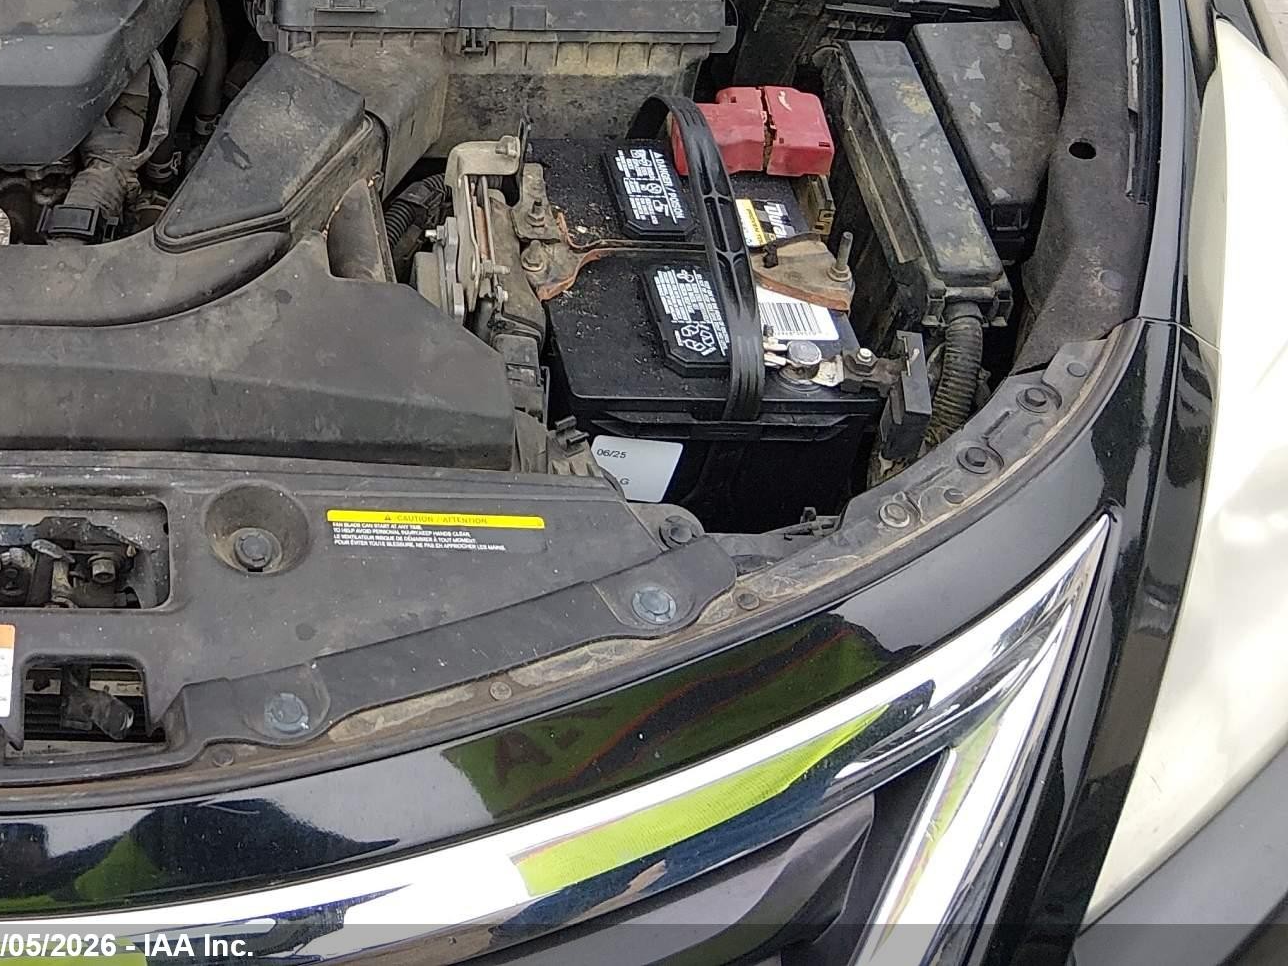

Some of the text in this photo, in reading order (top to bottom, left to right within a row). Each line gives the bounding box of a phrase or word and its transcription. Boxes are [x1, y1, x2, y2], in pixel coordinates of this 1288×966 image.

[656, 159, 674, 186] DANGER
[668, 193, 685, 218] POISON
[596, 448, 626, 458] 06/25
[619, 477, 630, 485] G
[442, 516, 487, 524] ATTENTION
